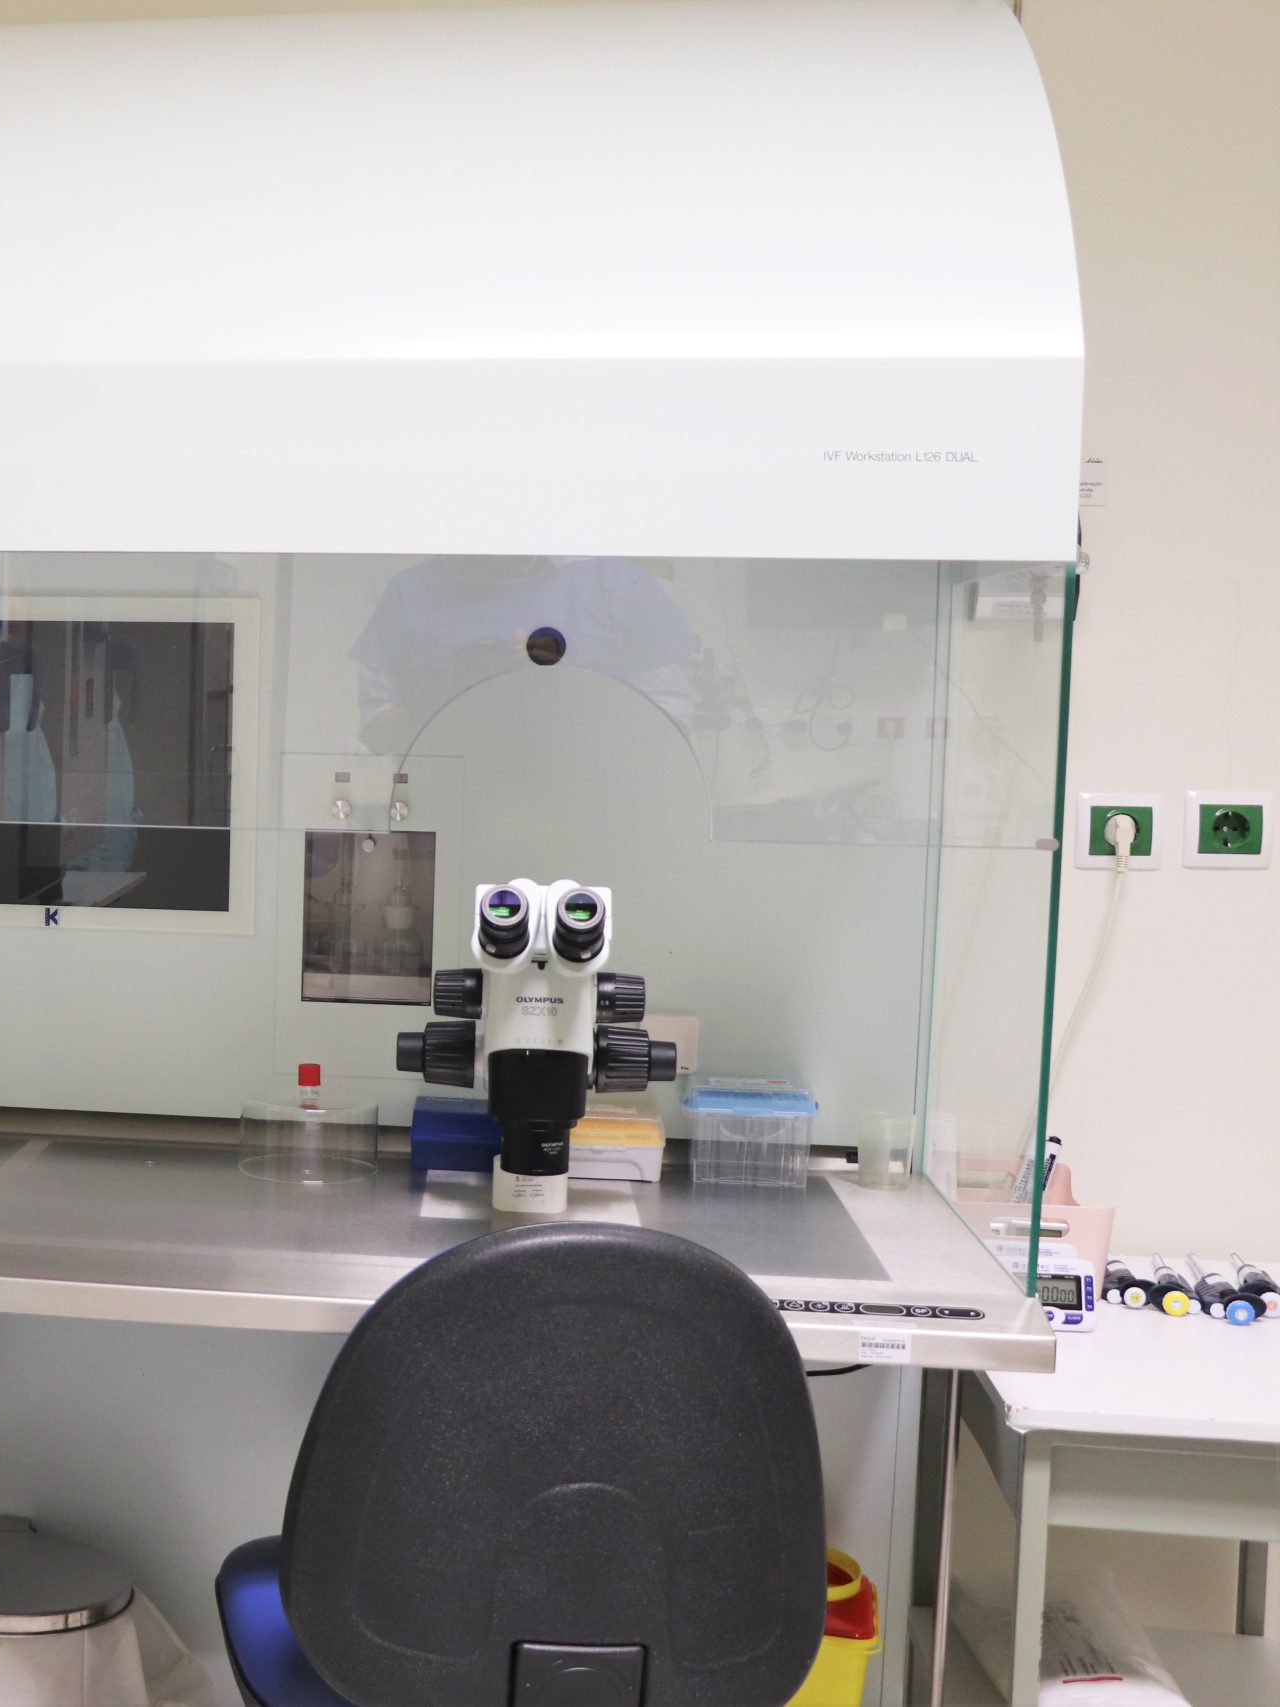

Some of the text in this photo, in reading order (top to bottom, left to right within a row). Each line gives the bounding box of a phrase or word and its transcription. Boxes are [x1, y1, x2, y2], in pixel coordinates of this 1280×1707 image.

[823, 450, 979, 463] IVF Workstation L126 DUAL
[44, 907, 59, 927] K
[515, 996, 565, 1004] OLYMPUS
[521, 1006, 559, 1017] SZX10
